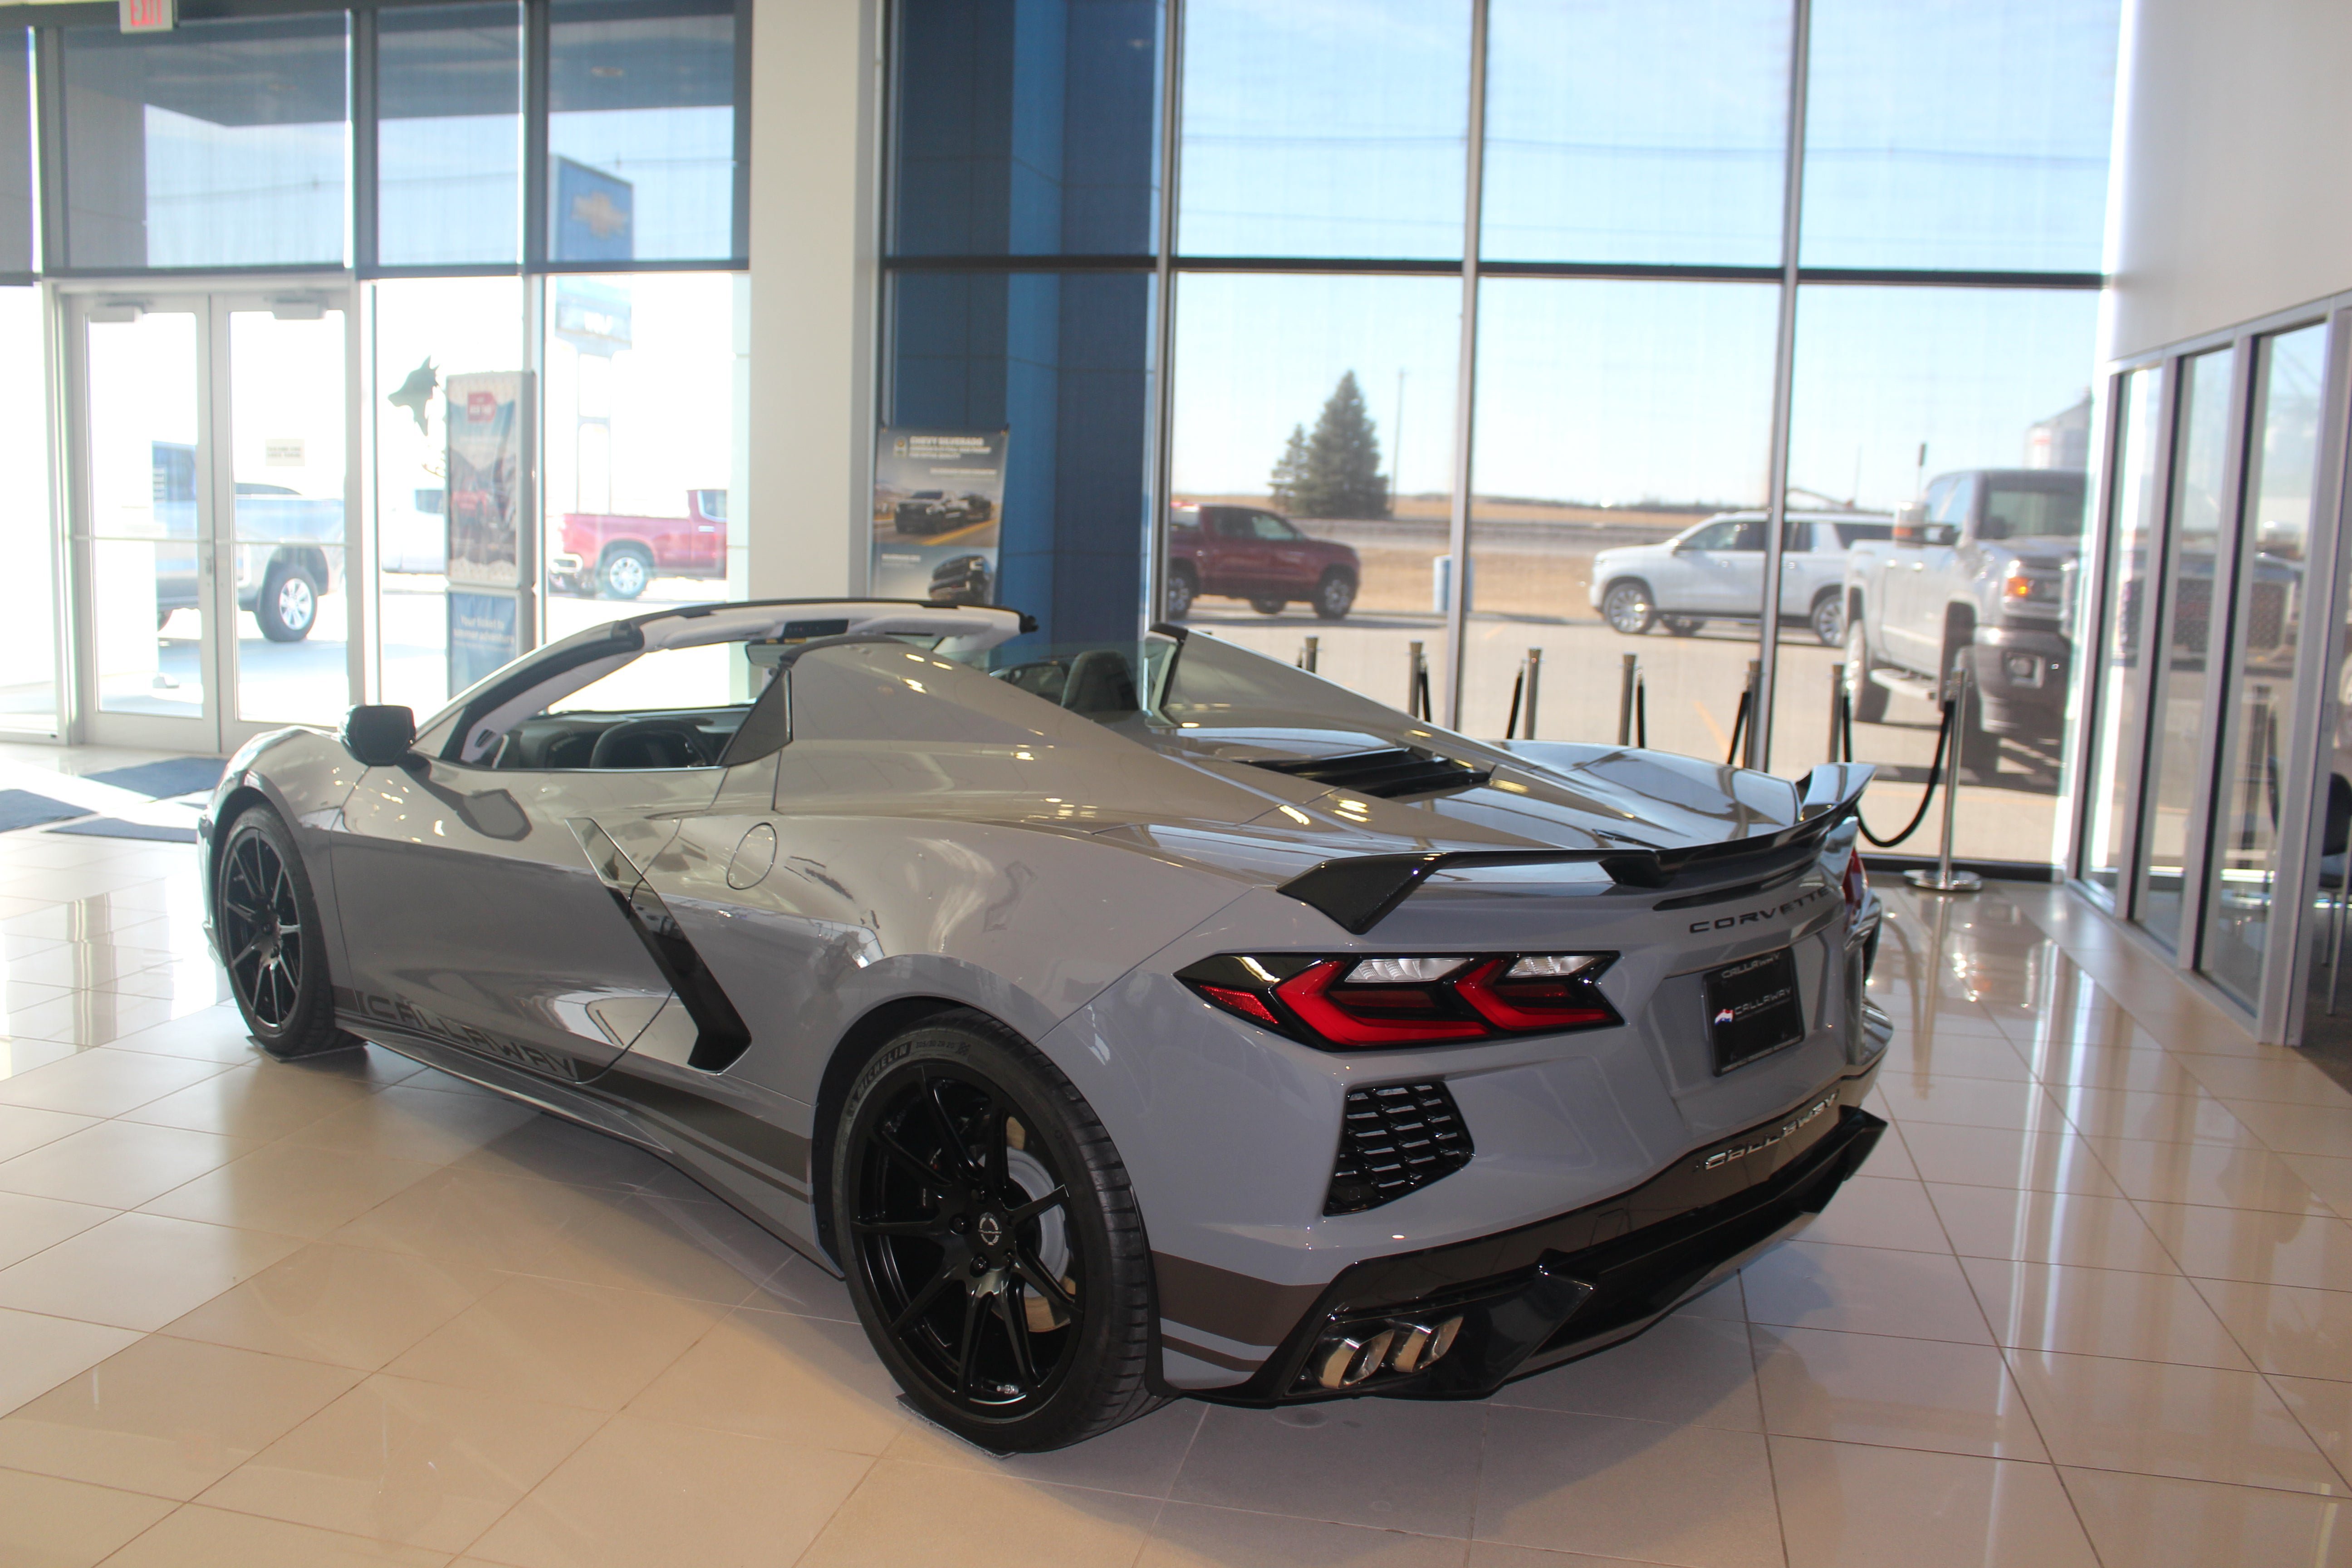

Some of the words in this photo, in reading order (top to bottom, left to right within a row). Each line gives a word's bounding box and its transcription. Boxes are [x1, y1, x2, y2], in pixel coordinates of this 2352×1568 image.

[130, 0, 162, 26] EXIT
[1689, 886, 1830, 933] CORVETTE
[1735, 986, 1791, 1015] CALLAWAY
[367, 995, 575, 1078] CALLAWAY
[857, 1043, 909, 1098] MICHELIN
[1705, 1091, 1838, 1171] CALLAWAY
